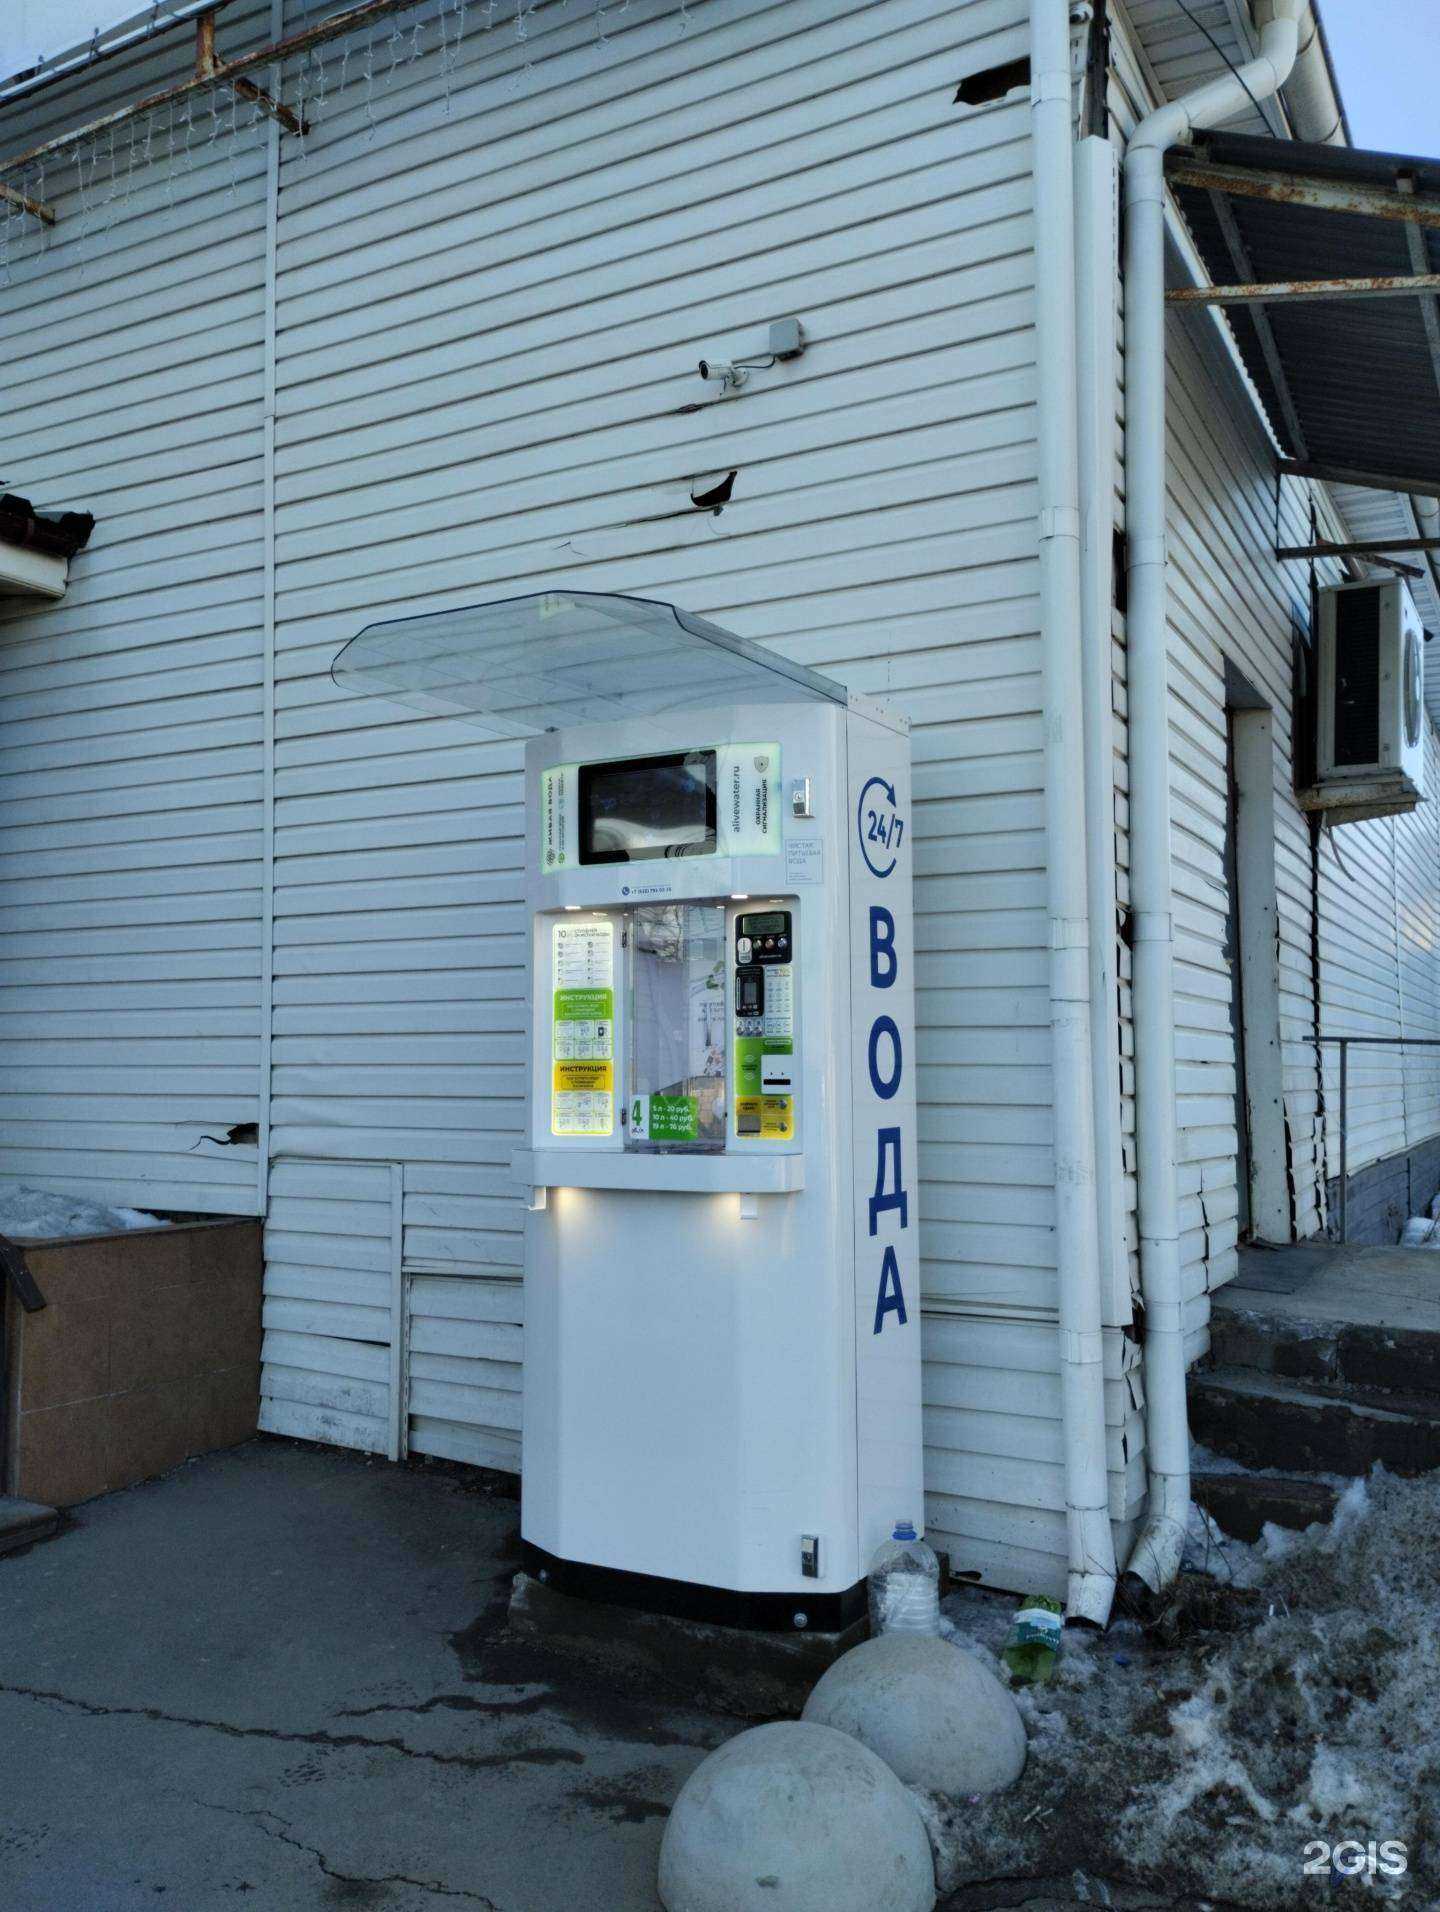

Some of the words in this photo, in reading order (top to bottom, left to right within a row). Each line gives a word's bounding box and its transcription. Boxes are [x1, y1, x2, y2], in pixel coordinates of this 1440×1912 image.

[731, 766, 741, 833] alivewater.ru
[867, 810, 904, 850] 24/7
[557, 930, 567, 938] 10
[560, 1065, 607, 1073] ИНСТРУКЦИЯ
[632, 1100, 642, 1127] 4
[868, 905, 908, 1335] ВОДА
